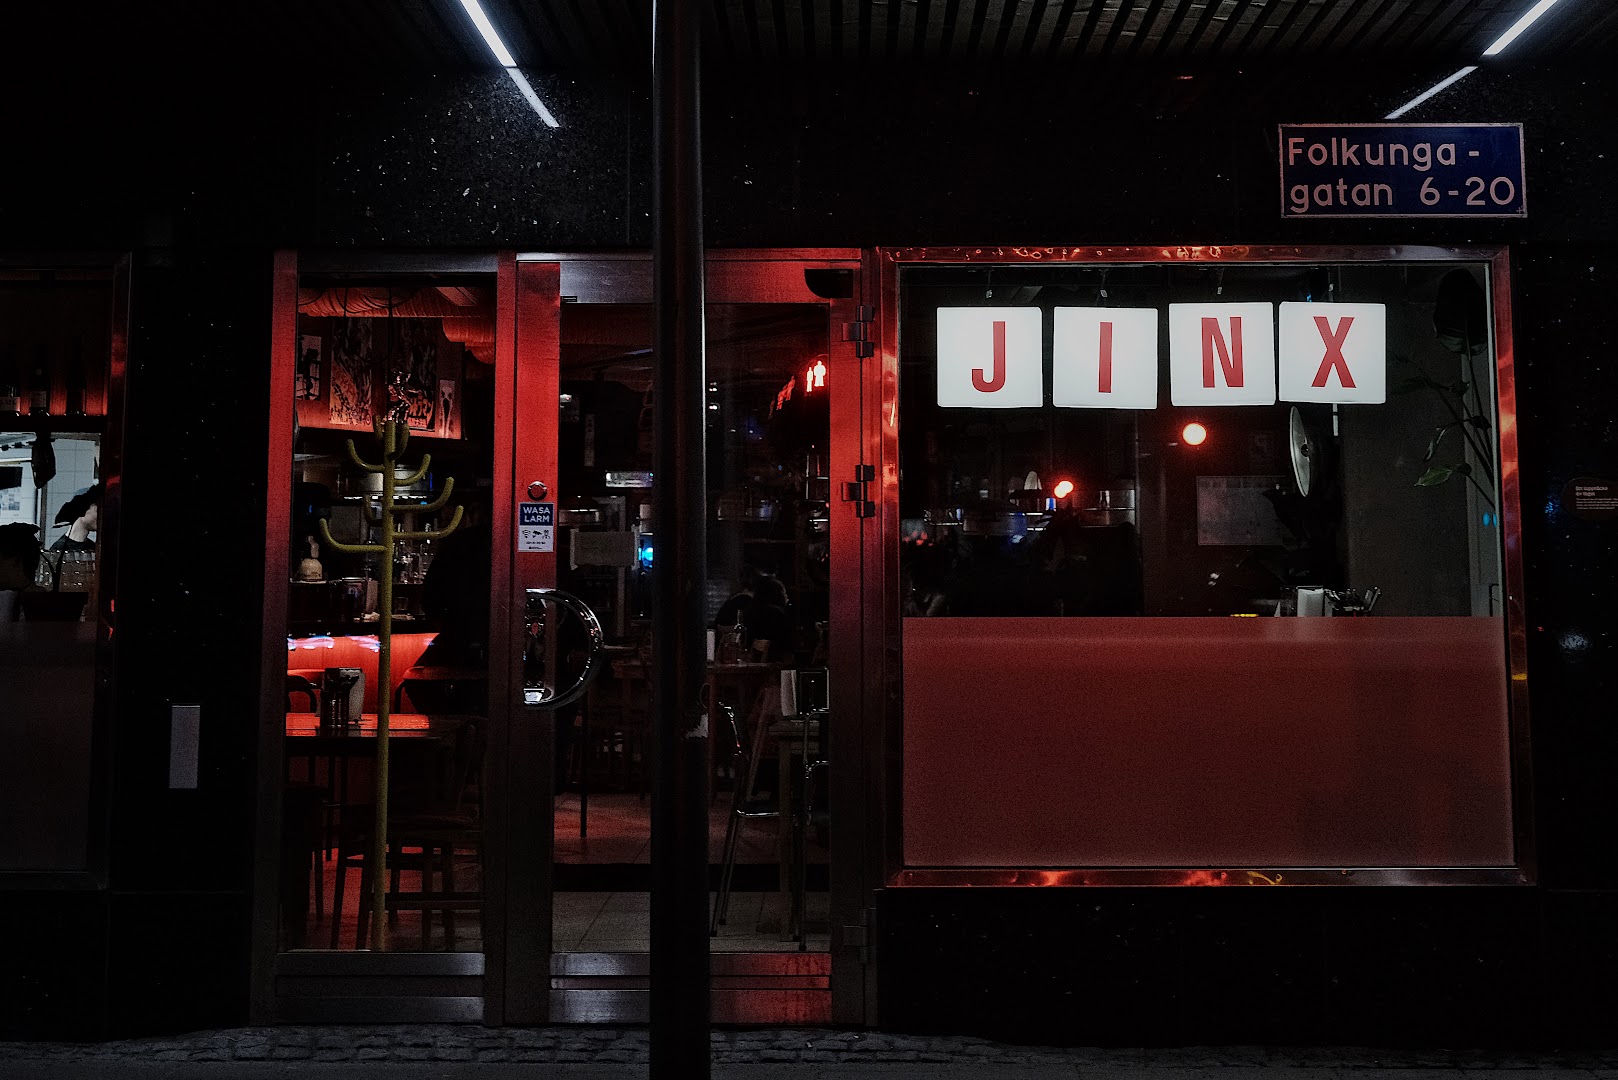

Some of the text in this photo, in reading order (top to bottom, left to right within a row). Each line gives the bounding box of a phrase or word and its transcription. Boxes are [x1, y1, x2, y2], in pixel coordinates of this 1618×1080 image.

[1289, 176, 1516, 213] gatan 6-20
[971, 316, 1357, 393] JINX
[524, 515, 550, 523] LARM
